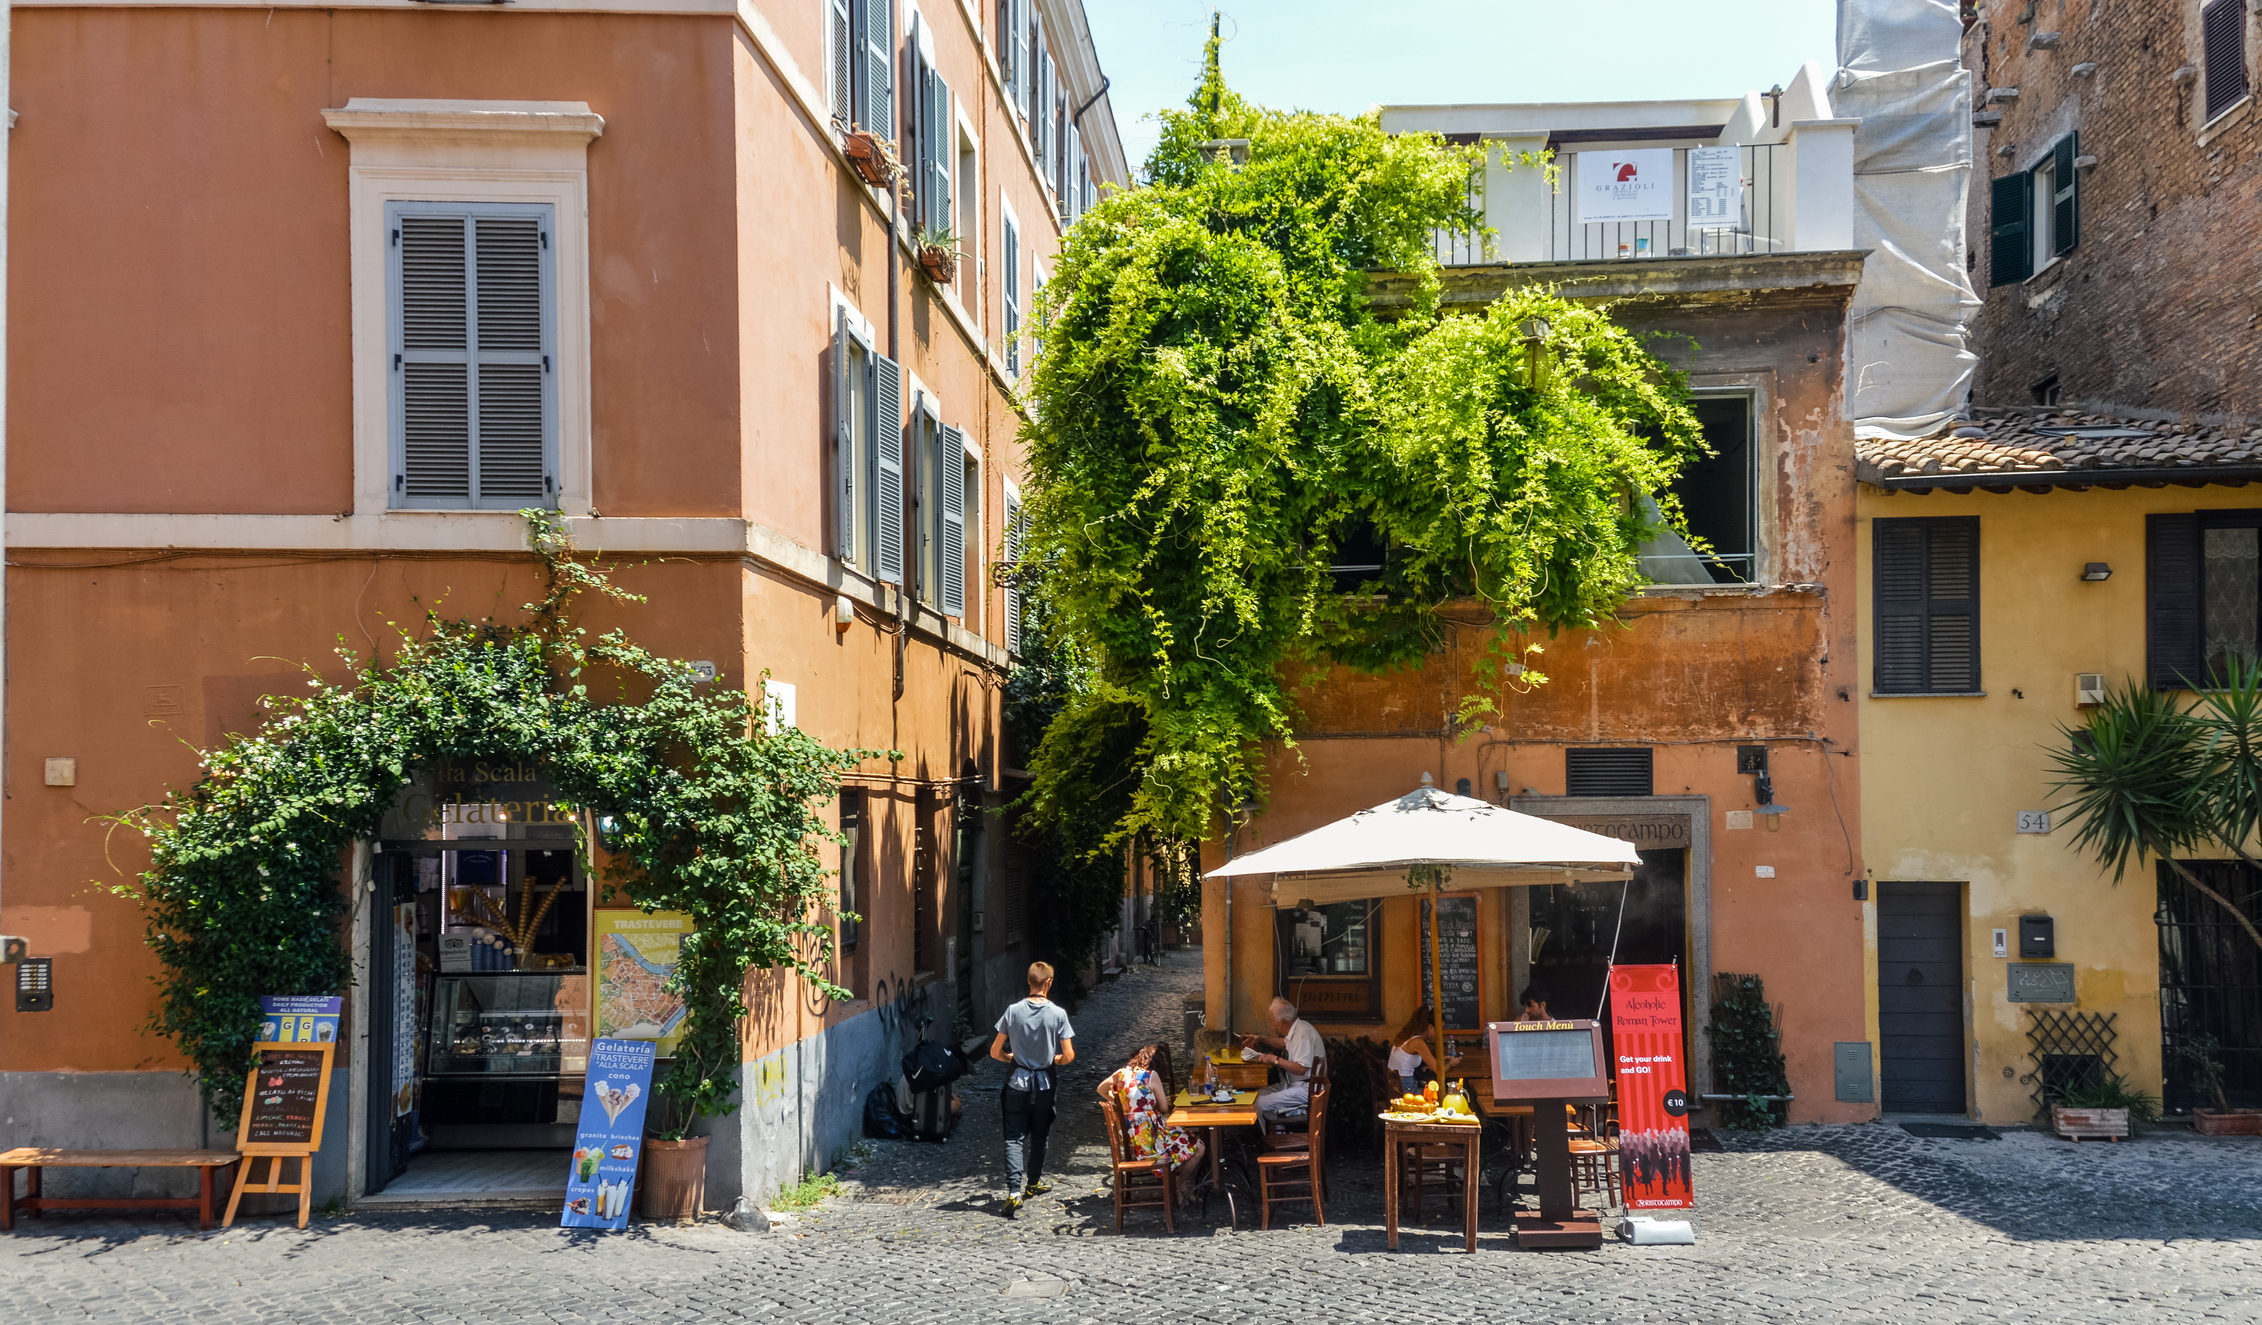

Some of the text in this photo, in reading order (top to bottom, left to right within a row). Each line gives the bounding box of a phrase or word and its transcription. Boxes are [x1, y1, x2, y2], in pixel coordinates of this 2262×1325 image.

[1595, 182, 1655, 192] GRAZIOLI
[437, 761, 465, 782] lla
[403, 792, 573, 825] Gelateria
[2020, 813, 2046, 831] 54
[613, 919, 683, 929] TRASTEVERE
[1442, 980, 1459, 989] PIZZA
[1301, 989, 1360, 1006] panini
[1625, 997, 1666, 1011] Alcoholic
[1513, 1020, 1575, 1032] Touch Menù
[1616, 1015, 1677, 1027] Roman Tower
[597, 1042, 651, 1054] Gelateria
[595, 1053, 650, 1065] TRASTEVERE
[1620, 1055, 1672, 1064] Get your drink
[1620, 1066, 1651, 1074] and GO!
[1667, 1099, 1684, 1107] € 10
[610, 1133, 640, 1141] brioches
[599, 1165, 635, 1173] milkshake
